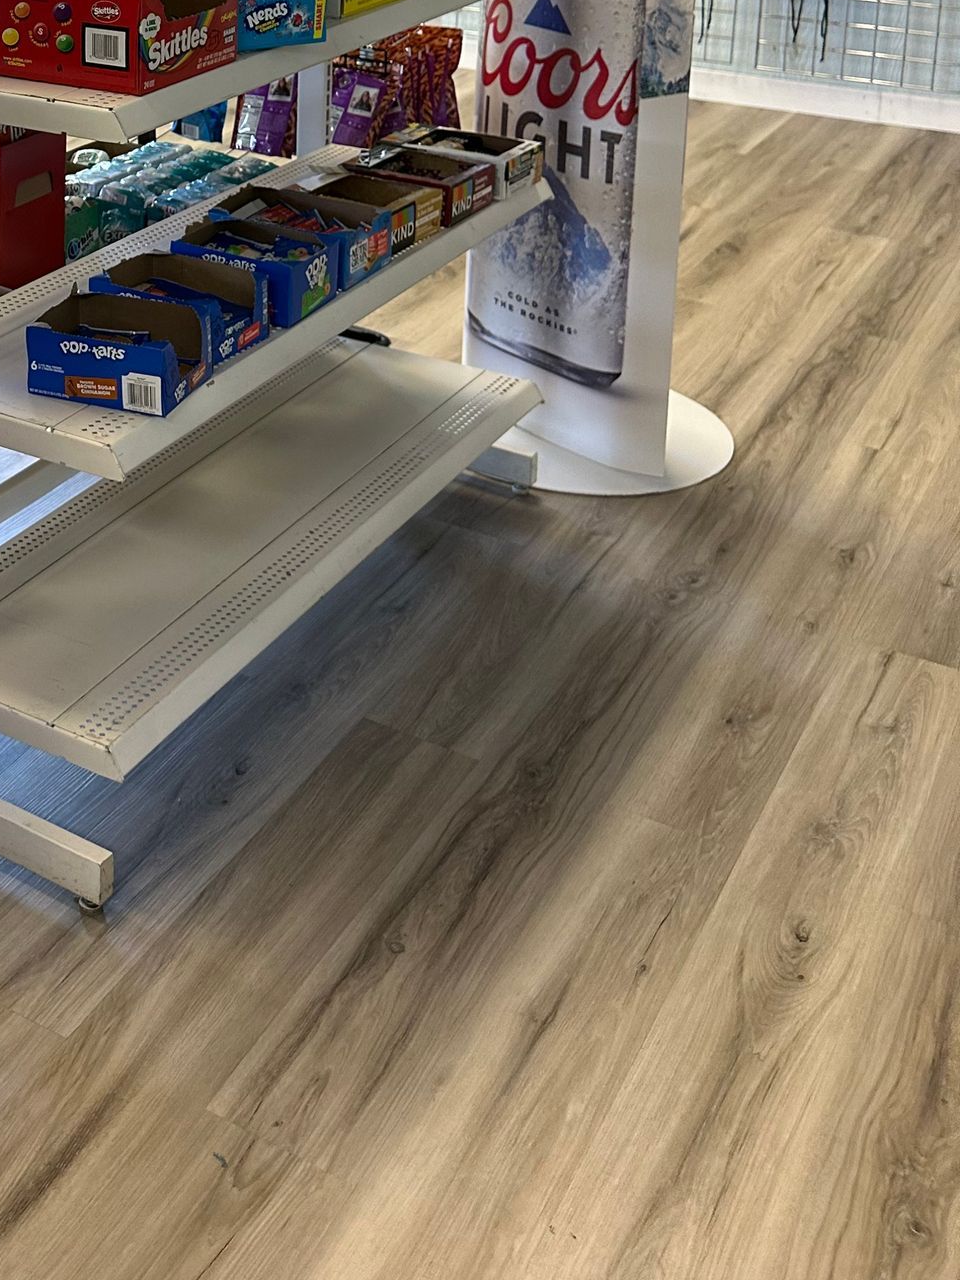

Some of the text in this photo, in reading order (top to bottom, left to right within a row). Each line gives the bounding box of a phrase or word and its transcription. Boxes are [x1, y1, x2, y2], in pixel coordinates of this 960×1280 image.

[93, 5, 120, 16] Skittles
[315, 1, 325, 32] SHARE
[148, 25, 209, 71] Skittles
[224, 35, 234, 44] SIZE
[451, 196, 473, 218] KIND
[390, 221, 415, 246] KIND
[507, 291, 560, 318] COLD AS
[493, 297, 573, 335] THE ROCKIES
[30, 360, 38, 370] 6
[76, 382, 98, 390] BROWN
[80, 388, 111, 397] CINNAMON
